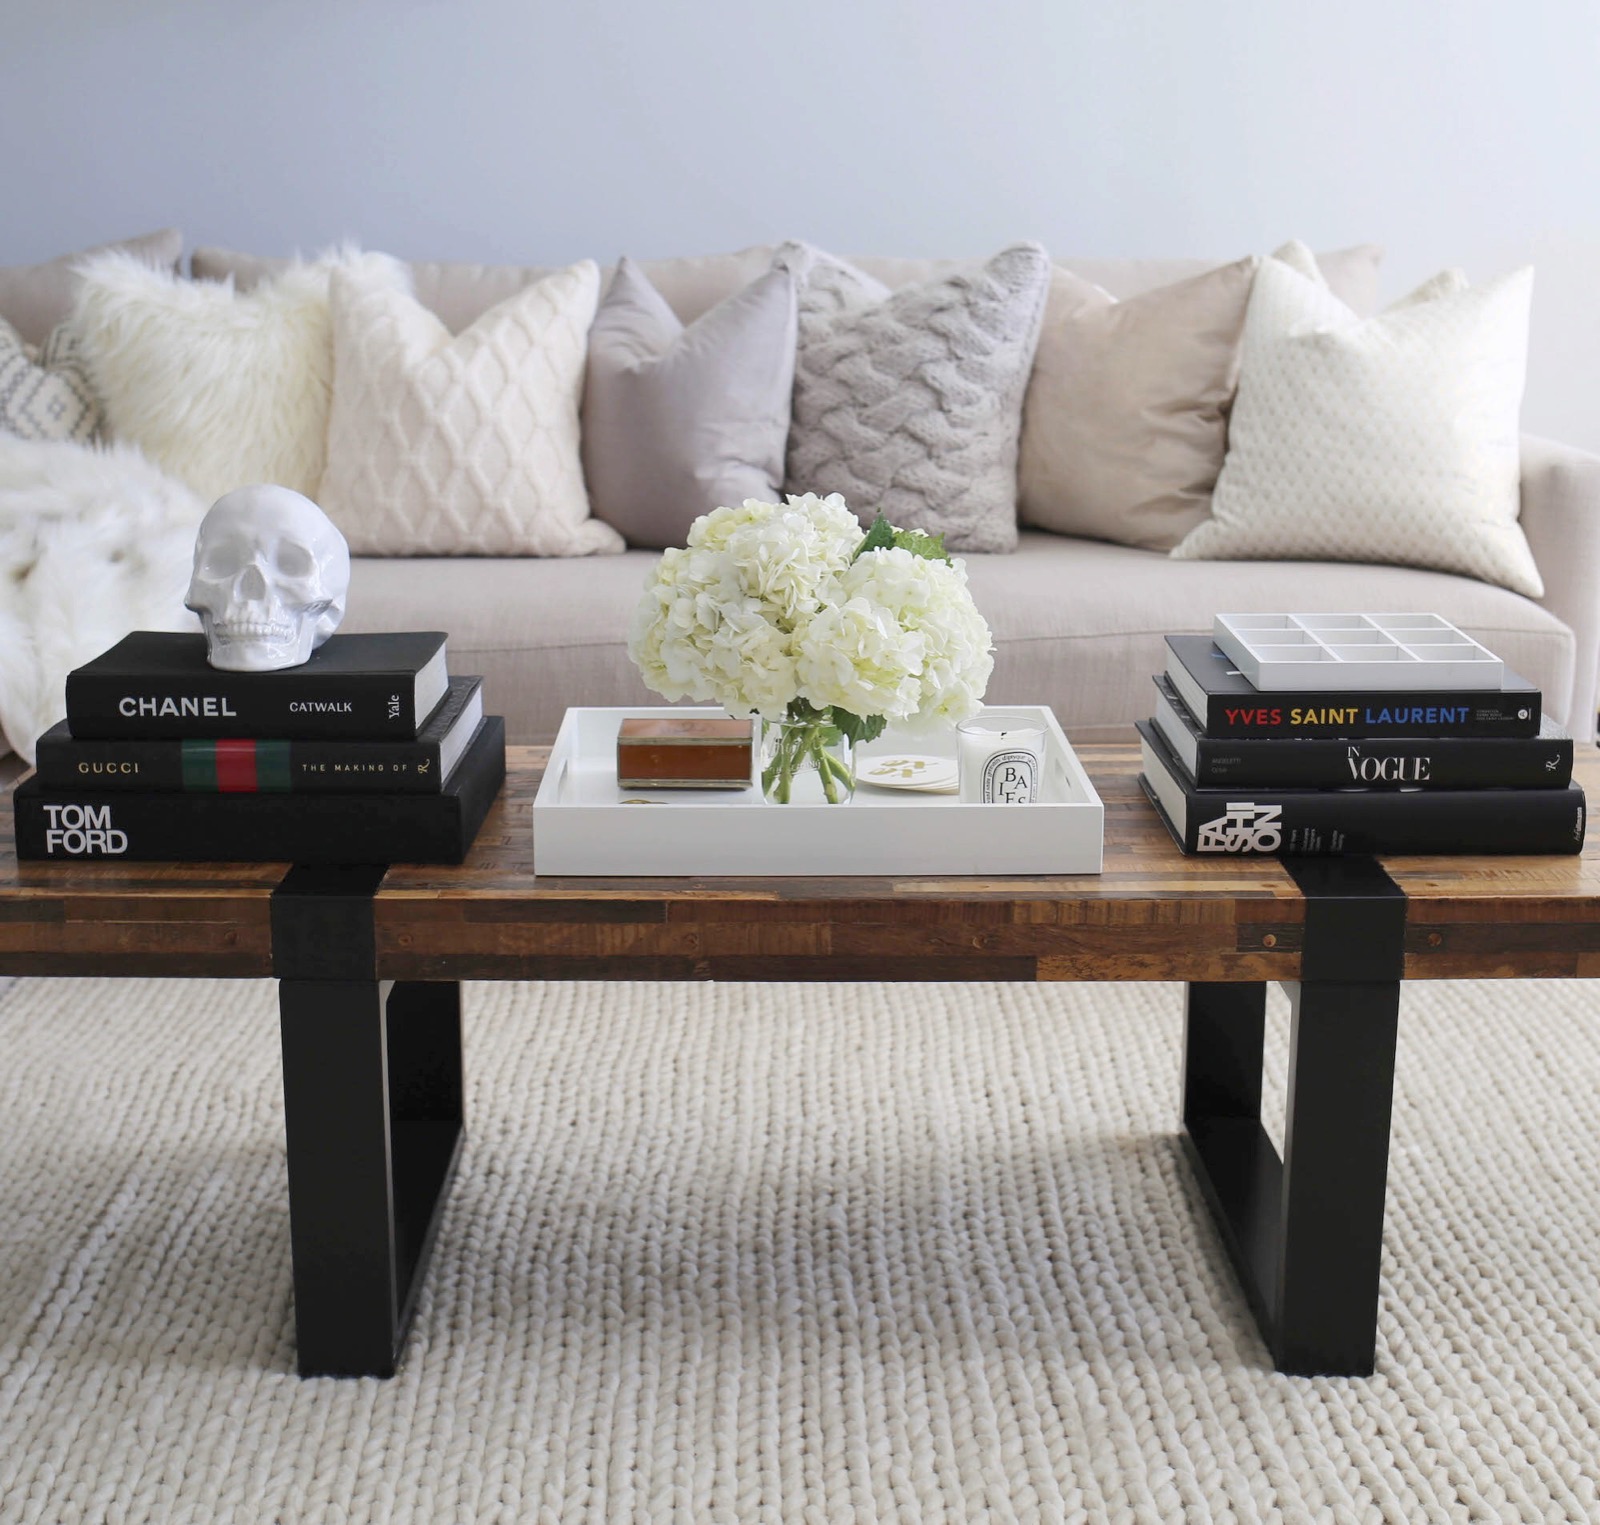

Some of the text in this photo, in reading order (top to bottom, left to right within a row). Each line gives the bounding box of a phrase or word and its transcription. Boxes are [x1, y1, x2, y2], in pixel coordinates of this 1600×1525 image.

[118, 697, 237, 717] CHANEL
[289, 701, 353, 713] CATWALK
[387, 694, 400, 720] Yale
[1225, 708, 1282, 725] YVES
[1290, 708, 1359, 725] SAINT
[1365, 707, 1470, 724] LAURENT
[1347, 746, 1360, 757] IN
[78, 762, 139, 774] GUCCI
[302, 764, 408, 772] THE MAKING OF
[1347, 757, 1431, 781] VOGUE
[43, 804, 112, 830] TOM
[46, 829, 129, 854] FORD
